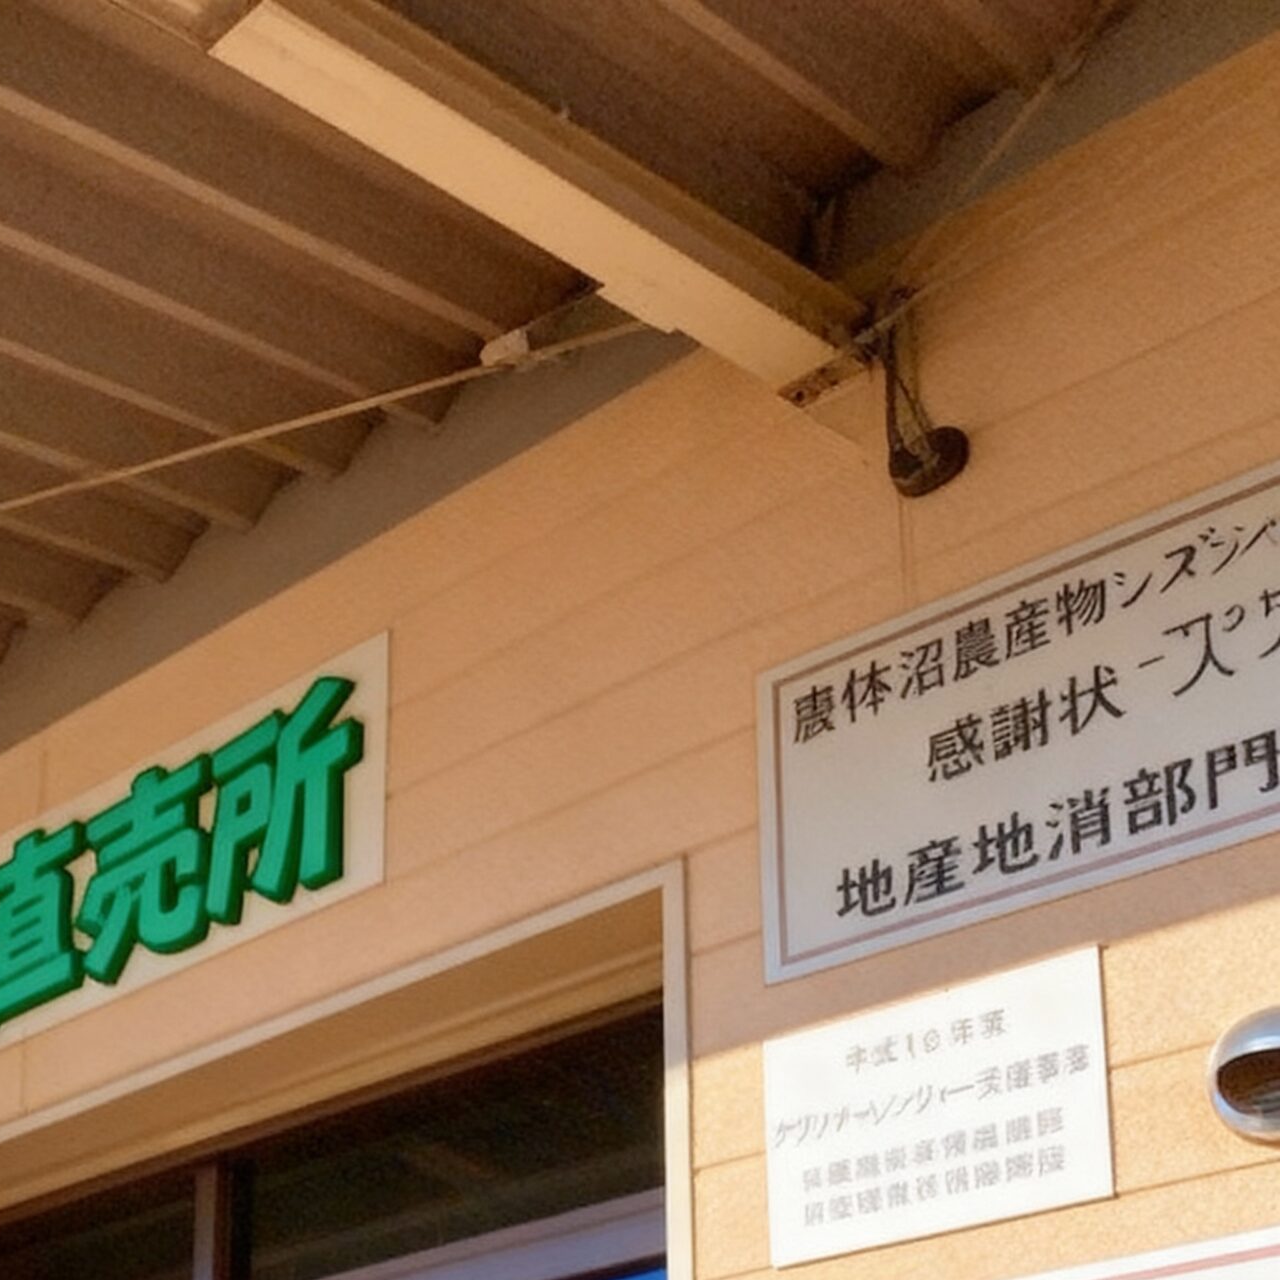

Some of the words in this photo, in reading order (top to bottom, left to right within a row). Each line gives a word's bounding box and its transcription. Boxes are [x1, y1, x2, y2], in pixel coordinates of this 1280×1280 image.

[836, 729, 1279, 919] 地産地消部門
